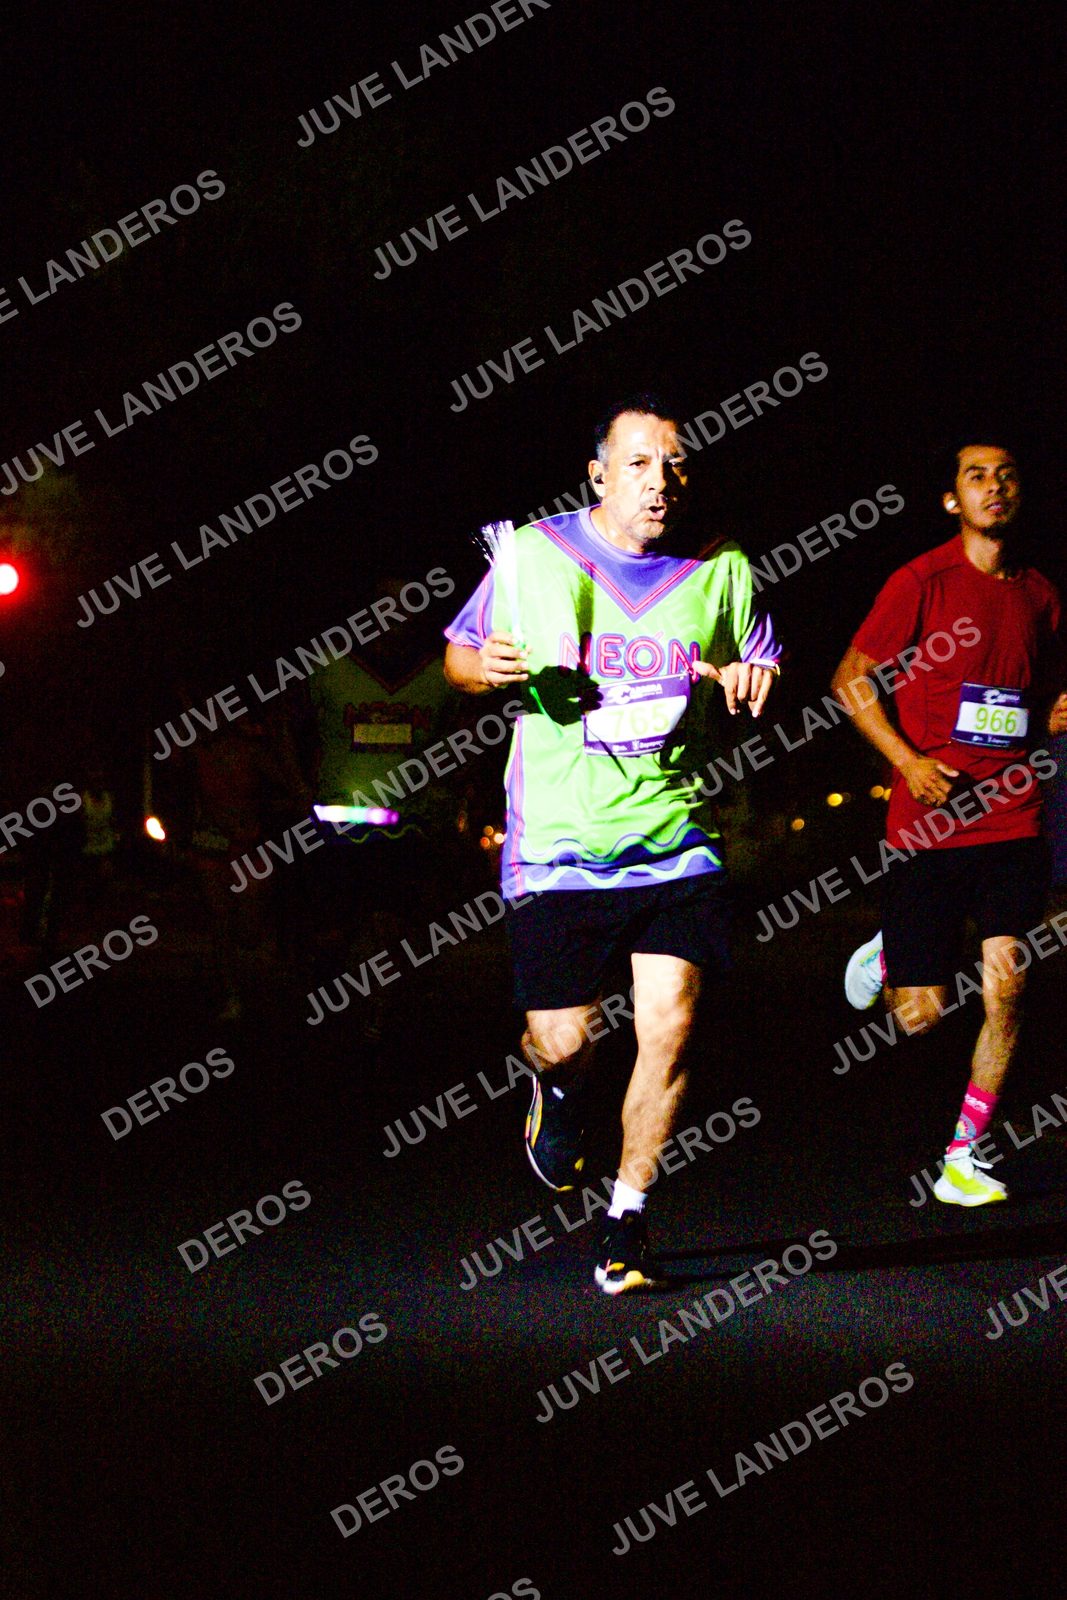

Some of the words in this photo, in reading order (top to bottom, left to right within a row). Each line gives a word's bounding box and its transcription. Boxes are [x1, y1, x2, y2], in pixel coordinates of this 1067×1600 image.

[560, 631, 701, 684] NEÓN
[608, 703, 670, 738] 765
[974, 706, 1018, 734] 966
